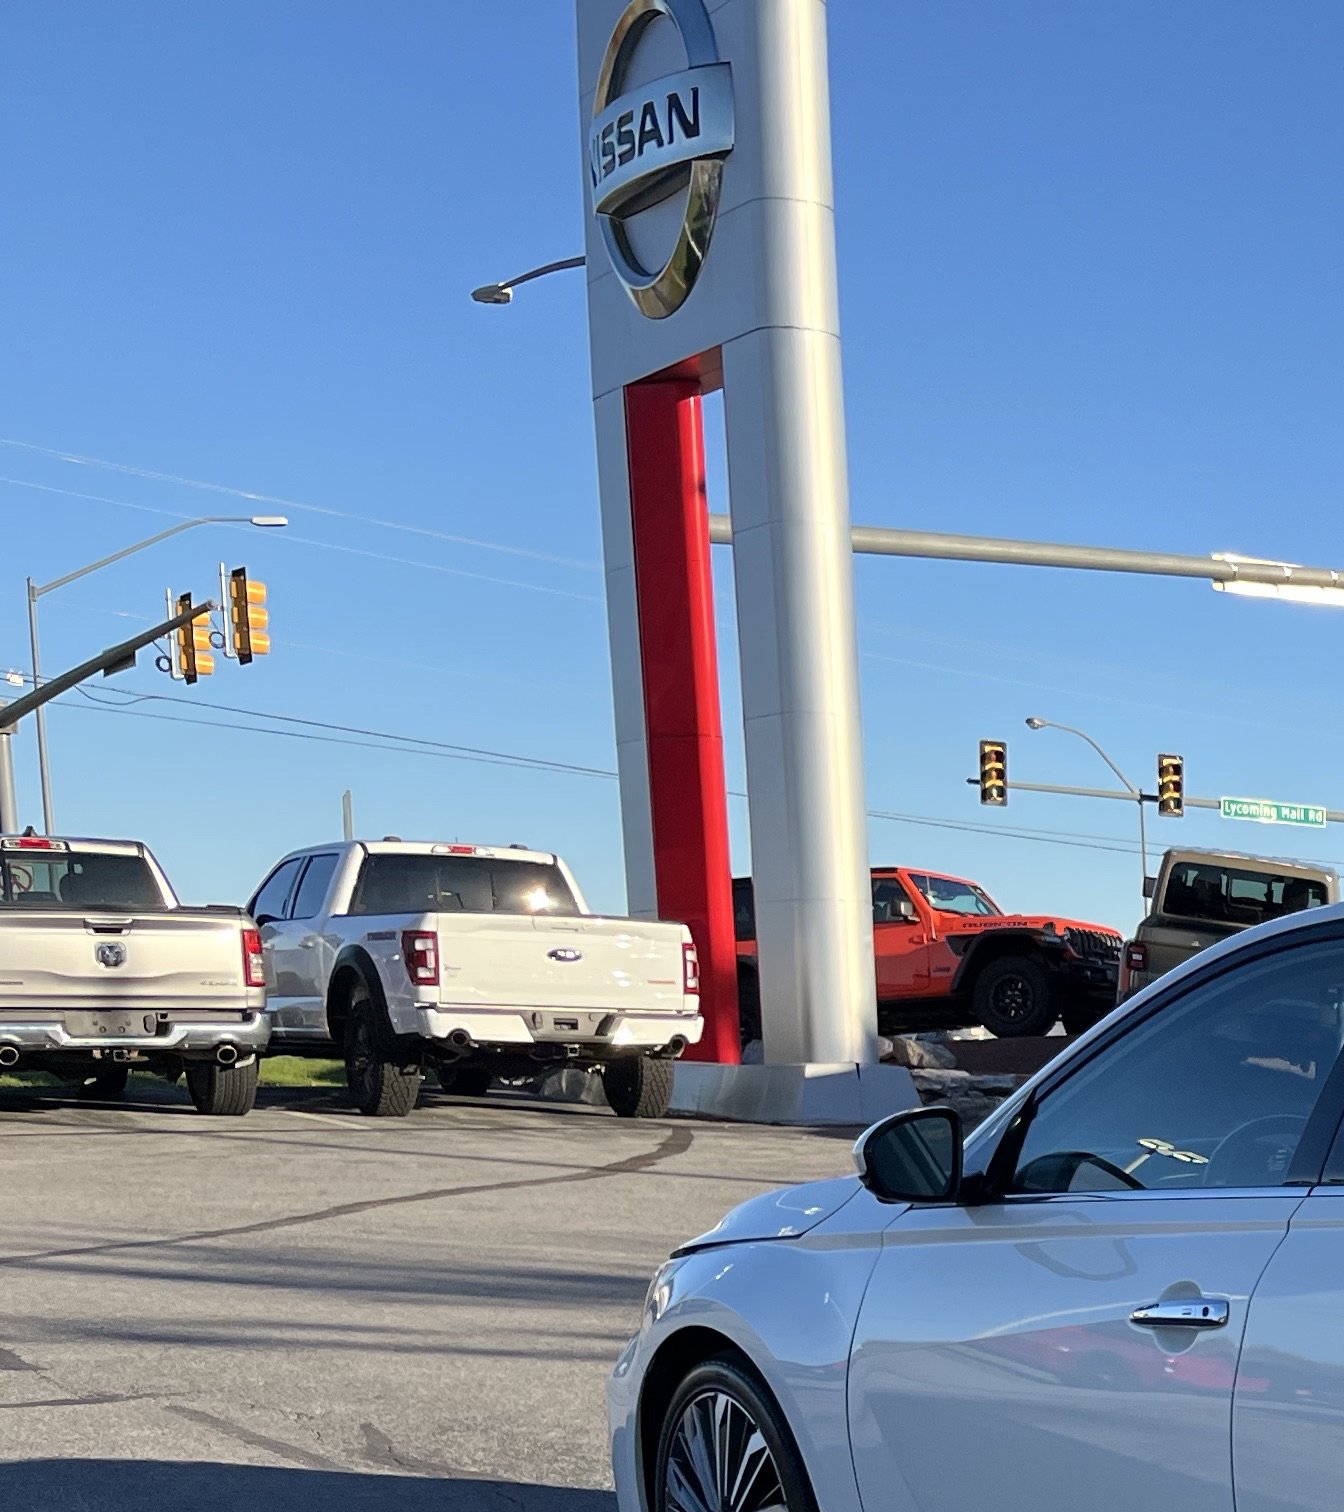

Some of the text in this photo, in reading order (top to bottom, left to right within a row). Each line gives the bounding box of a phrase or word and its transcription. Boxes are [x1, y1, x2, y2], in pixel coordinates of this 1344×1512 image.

[588, 86, 700, 189] NISSAN
[1224, 800, 1323, 823] Lycoming Mall Rd
